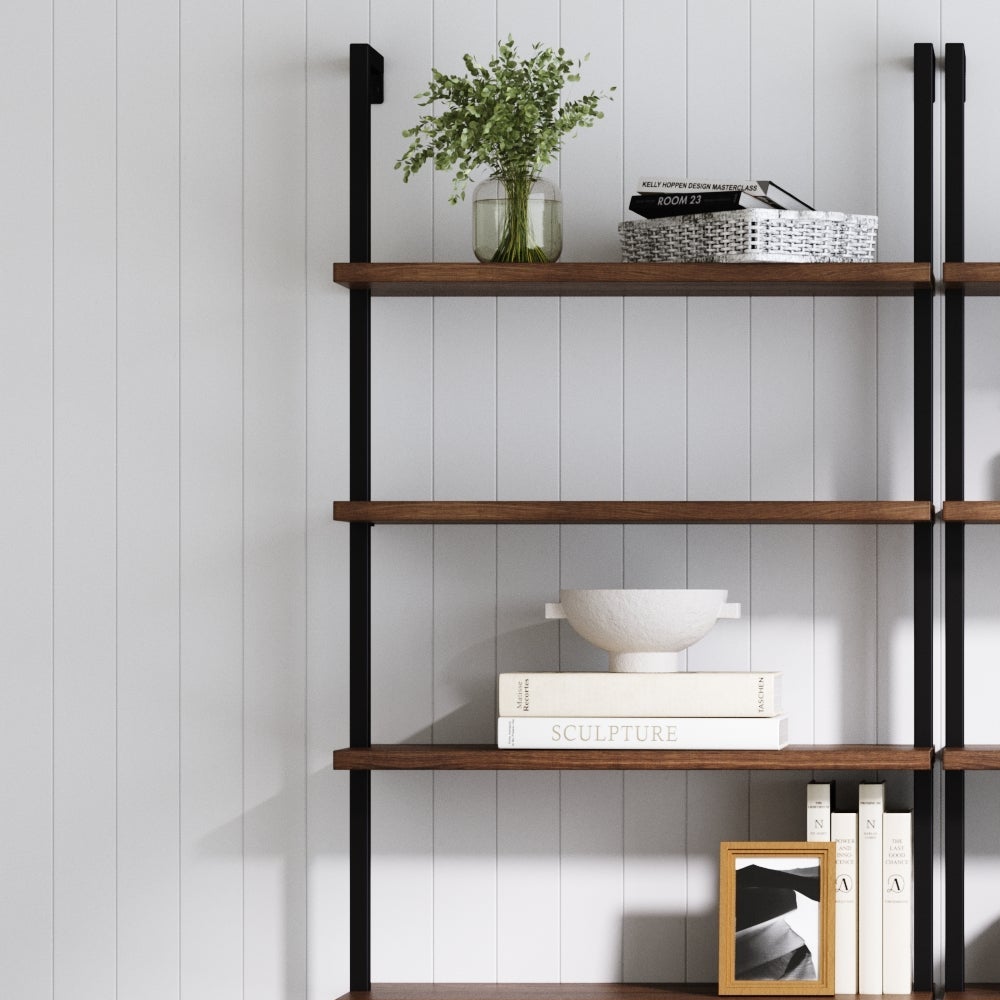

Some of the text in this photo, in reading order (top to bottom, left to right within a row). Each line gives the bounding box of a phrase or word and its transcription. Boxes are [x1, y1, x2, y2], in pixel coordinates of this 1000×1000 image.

[688, 182, 711, 190] DESIGN
[712, 184, 758, 192] MASTERCLASS
[658, 194, 702, 206] ROOM 23
[551, 724, 678, 742] SCULPTURE
[814, 819, 823, 829] N
[866, 819, 875, 829] N
